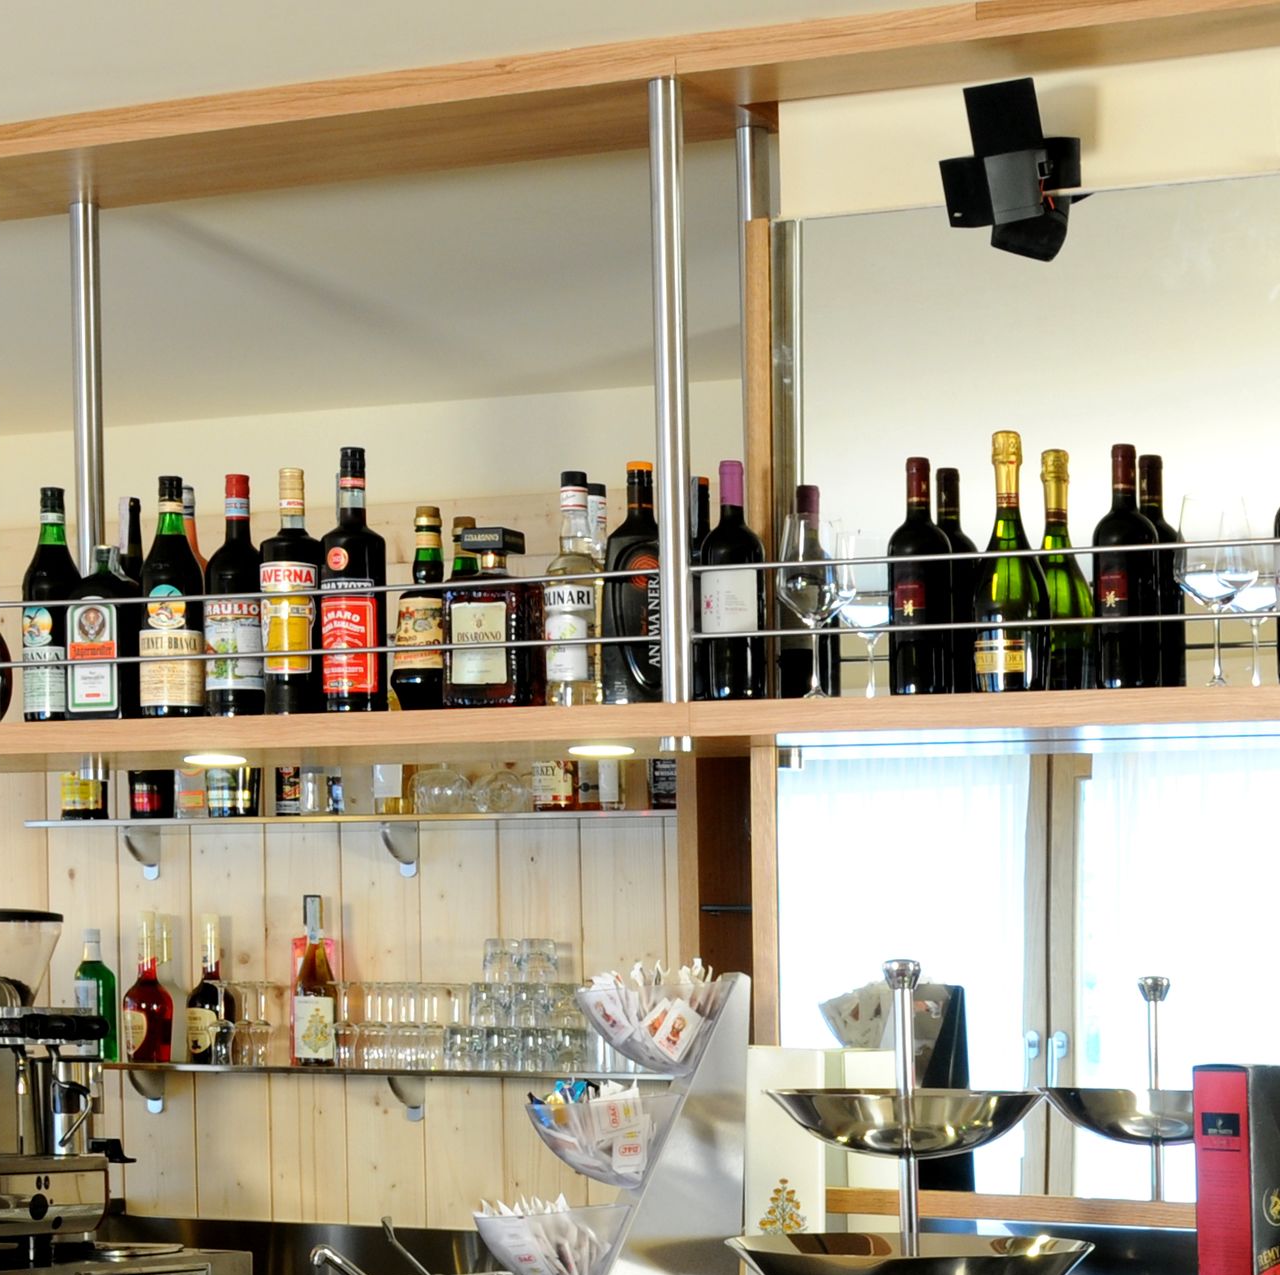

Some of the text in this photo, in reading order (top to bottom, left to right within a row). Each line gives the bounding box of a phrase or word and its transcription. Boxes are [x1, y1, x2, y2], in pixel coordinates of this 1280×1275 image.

[262, 568, 313, 584] AVERNA
[543, 590, 591, 606] OLINARI
[205, 601, 259, 615] RAULIO
[323, 610, 361, 624] AMARO
[457, 631, 502, 643] DISARONNO
